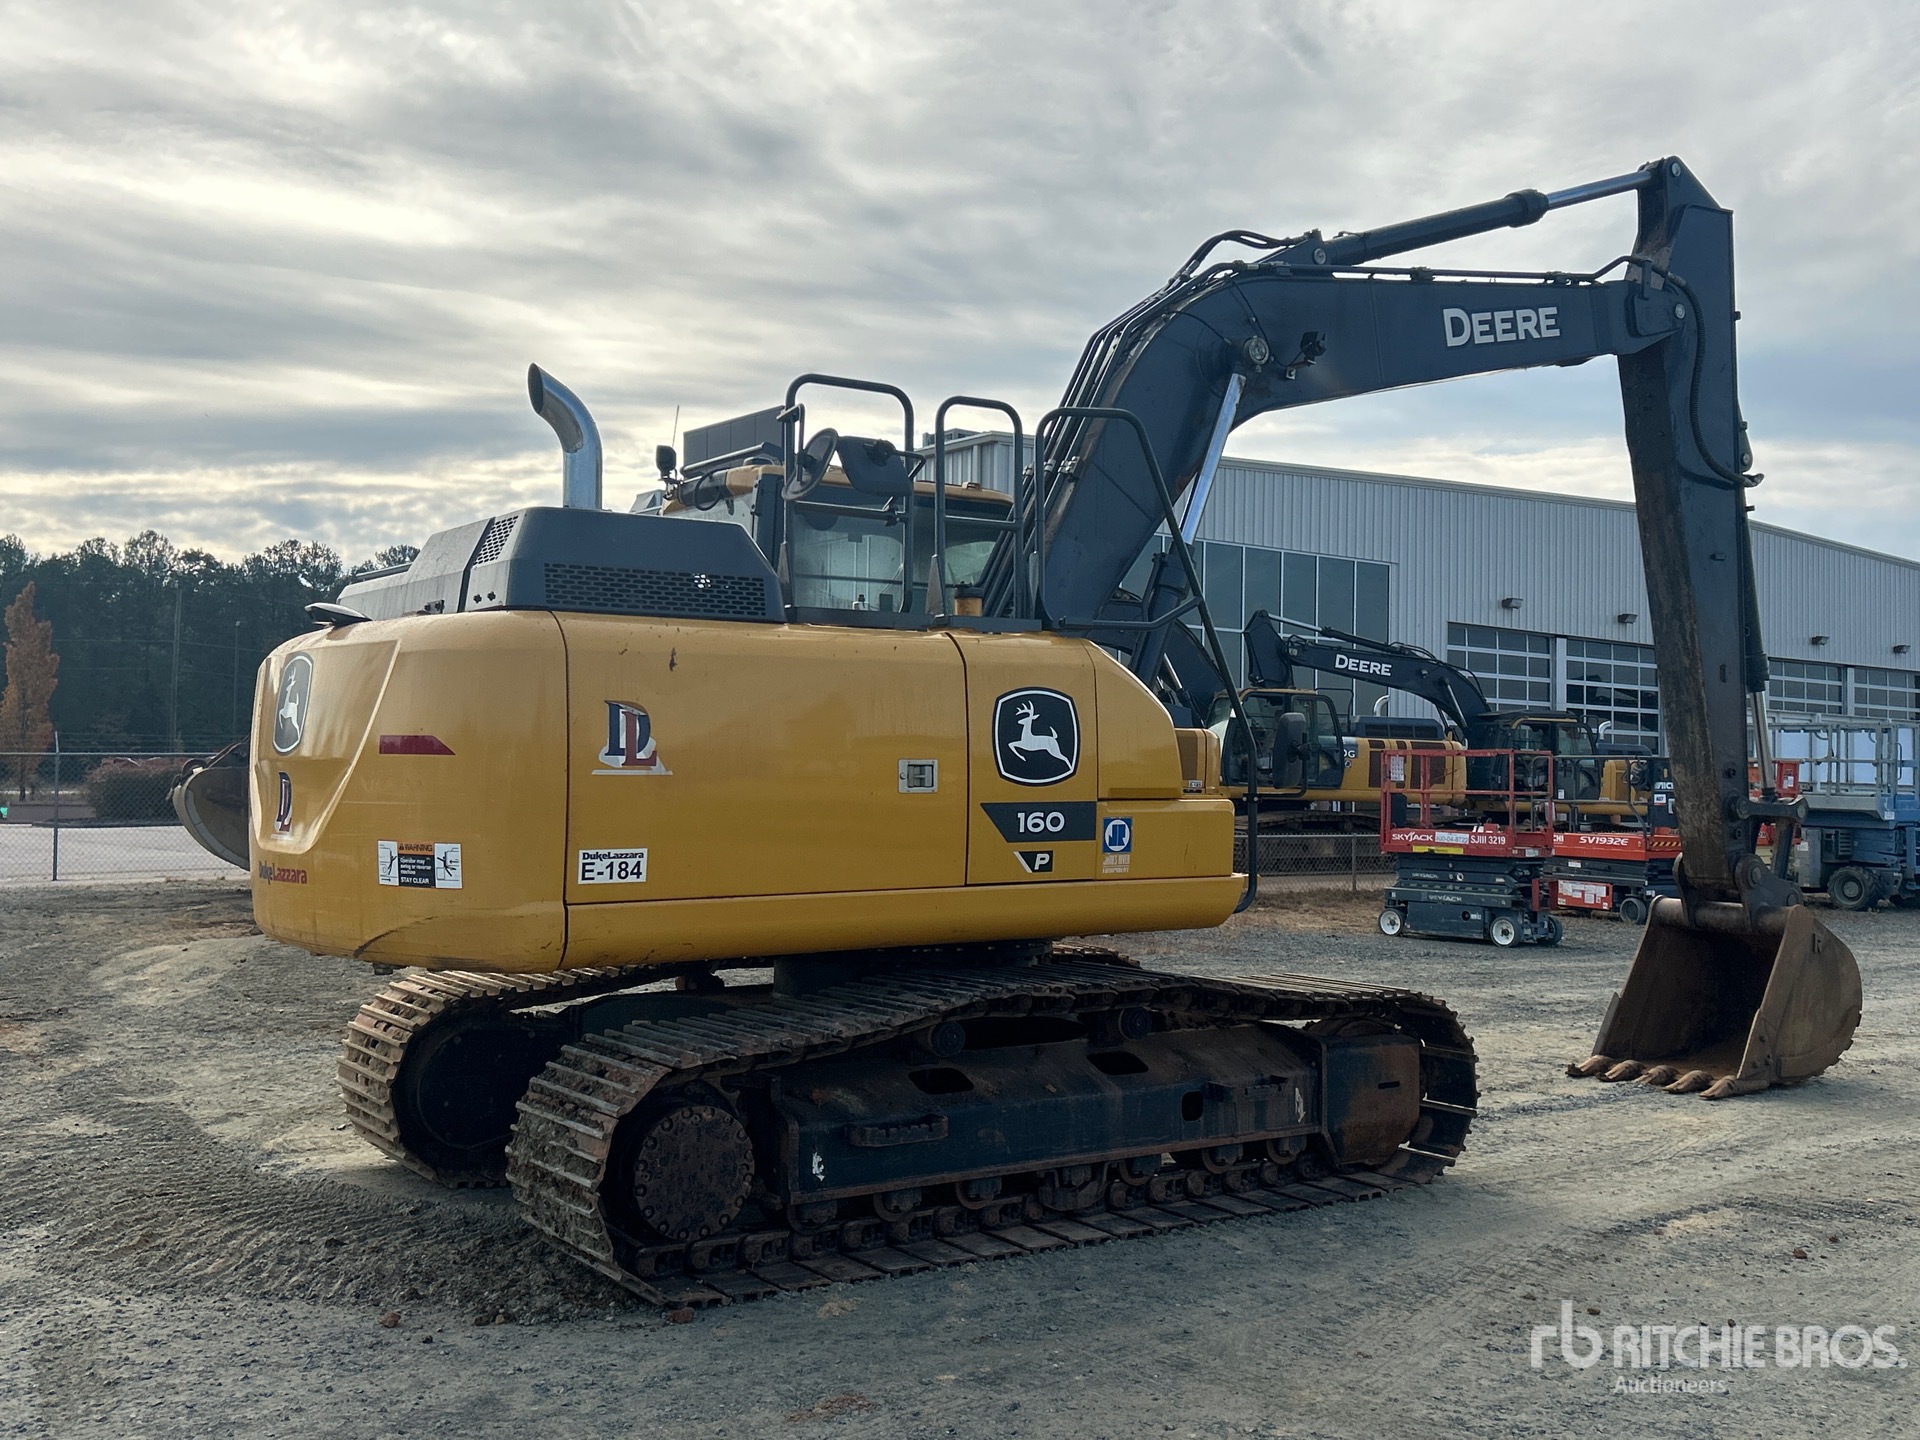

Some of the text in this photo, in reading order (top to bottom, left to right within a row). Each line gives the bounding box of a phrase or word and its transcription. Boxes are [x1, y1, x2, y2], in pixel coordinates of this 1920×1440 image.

[1443, 307, 1560, 347] DEERE
[1335, 654, 1392, 676] DEERE
[1017, 811, 1065, 833] 160
[405, 843, 433, 851] WARNING
[1392, 831, 1433, 842] SKYJACK
[1488, 836, 1506, 845] 3219
[1579, 836, 1629, 846] SV1932E
[582, 851, 644, 861] DukeLazzara
[1034, 853, 1050, 870] P
[258, 861, 308, 885] DukeLazzara
[581, 861, 643, 881] E-184
